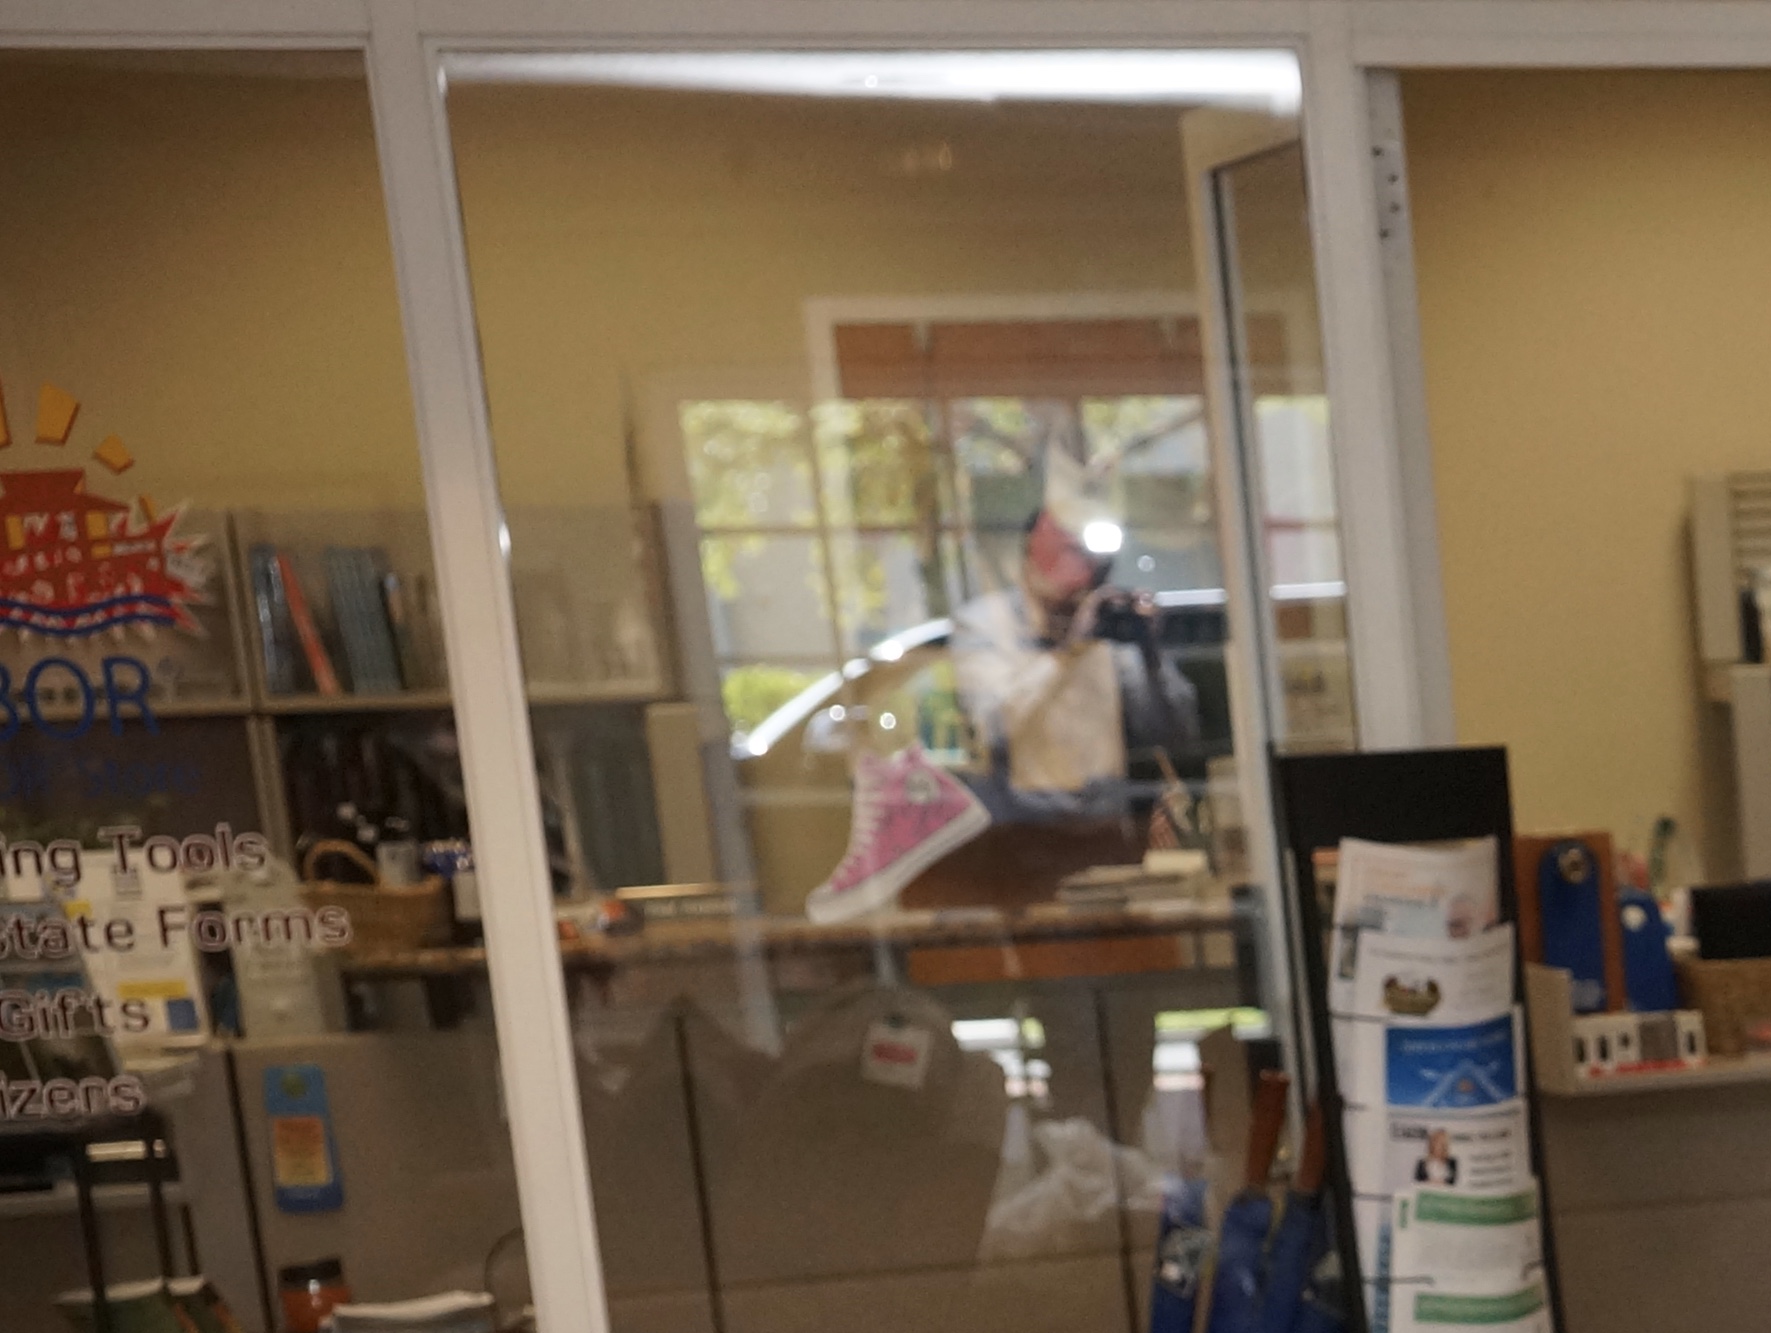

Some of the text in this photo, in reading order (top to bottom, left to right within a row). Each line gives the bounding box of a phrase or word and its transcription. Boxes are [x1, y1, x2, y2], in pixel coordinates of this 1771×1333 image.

[98, 820, 272, 876] Tools
[157, 904, 354, 952] Forms
[0, 986, 152, 1042] Gifts
